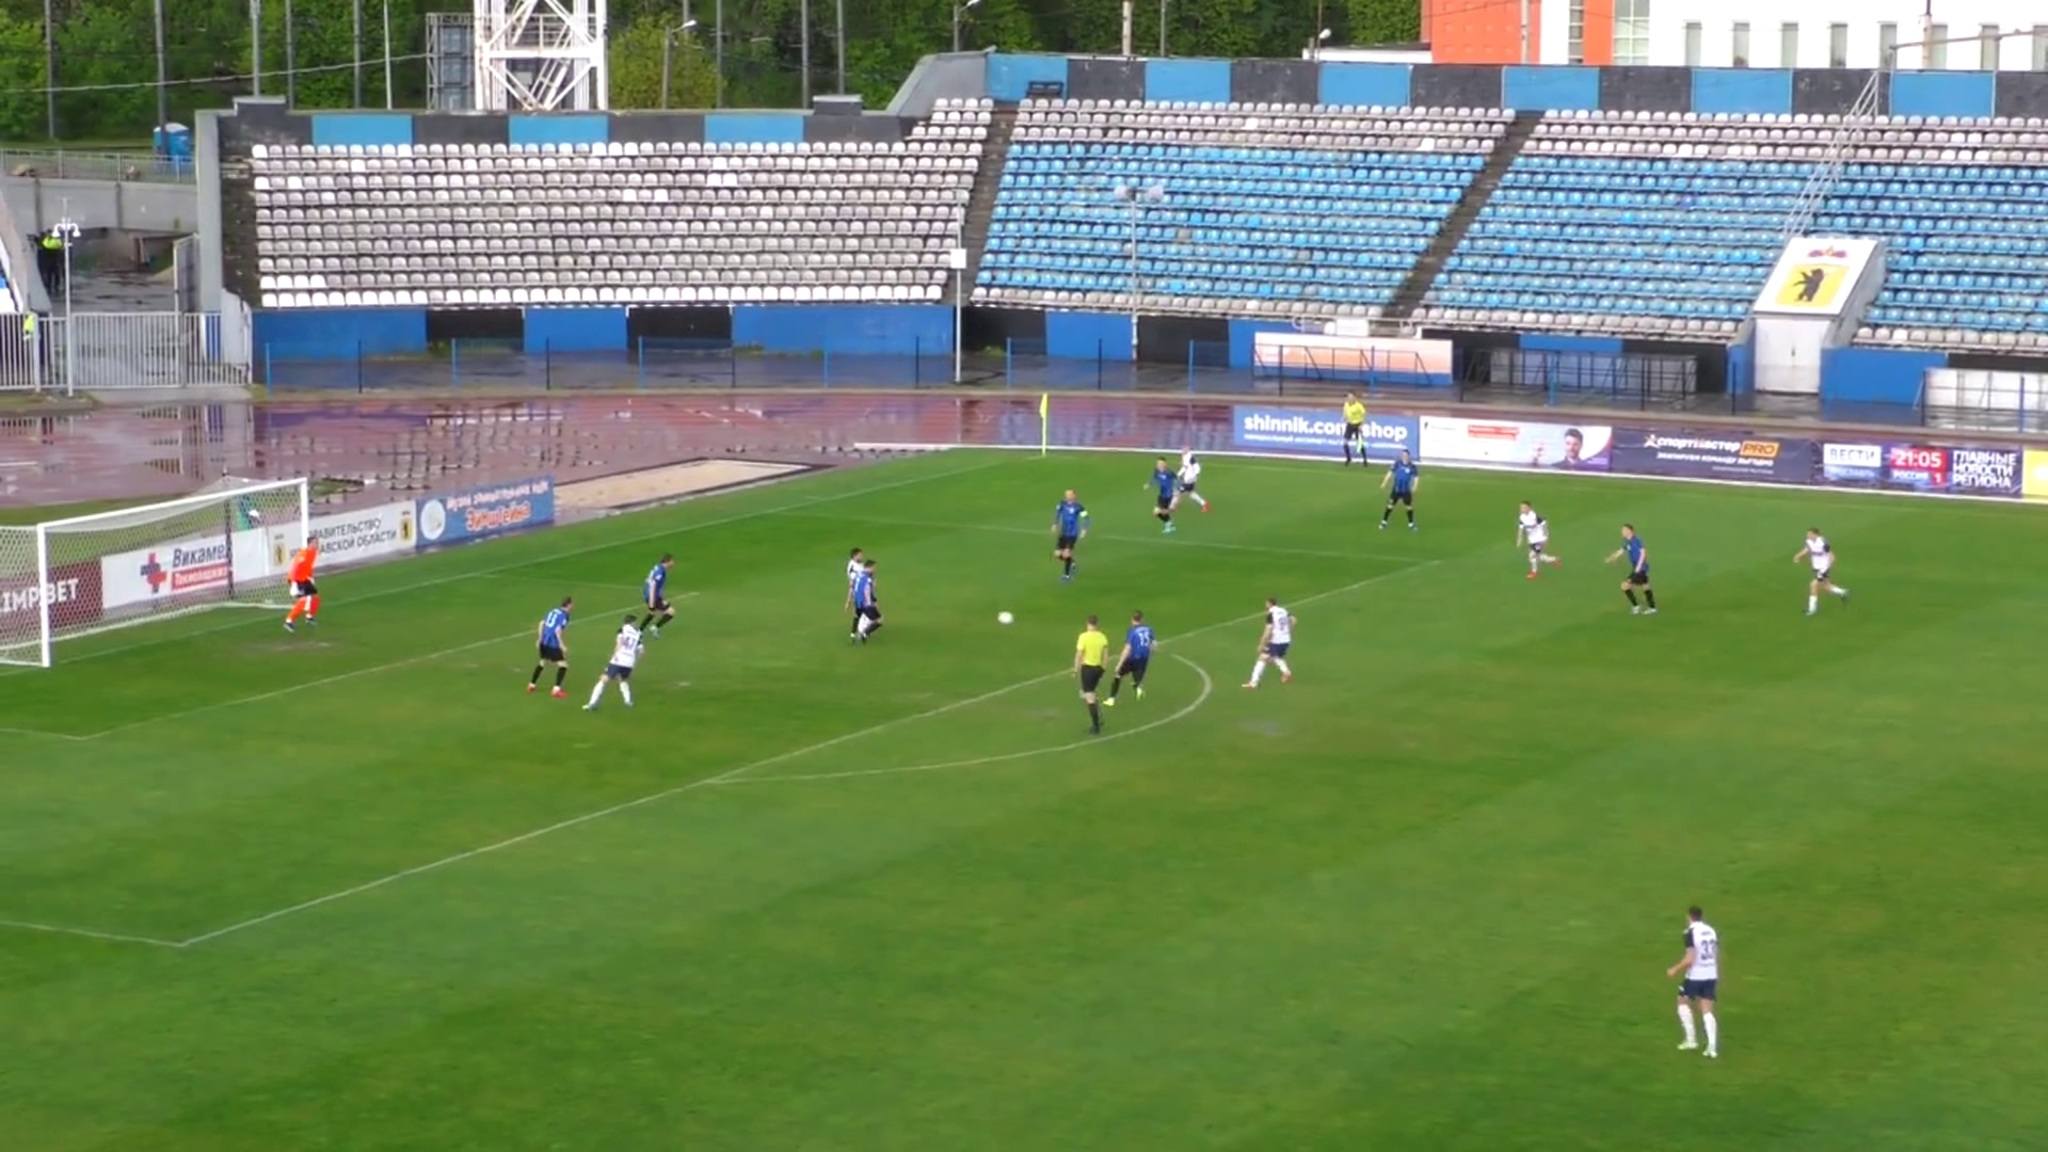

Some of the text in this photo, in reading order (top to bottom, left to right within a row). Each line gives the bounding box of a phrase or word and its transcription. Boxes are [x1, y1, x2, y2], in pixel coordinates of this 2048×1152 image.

[1743, 440, 1776, 455] PRO
[1830, 448, 1875, 461] ВЕСТИ
[1894, 450, 1942, 468] 21:05
[1953, 450, 2016, 466] ГЛАВНЫЕ
[1953, 462, 2013, 477] НОВОСТИ
[1953, 474, 2012, 488] РЕГИОНА
[357, 529, 398, 549] ОБЛАСТИ
[172, 543, 231, 568] Викаме
